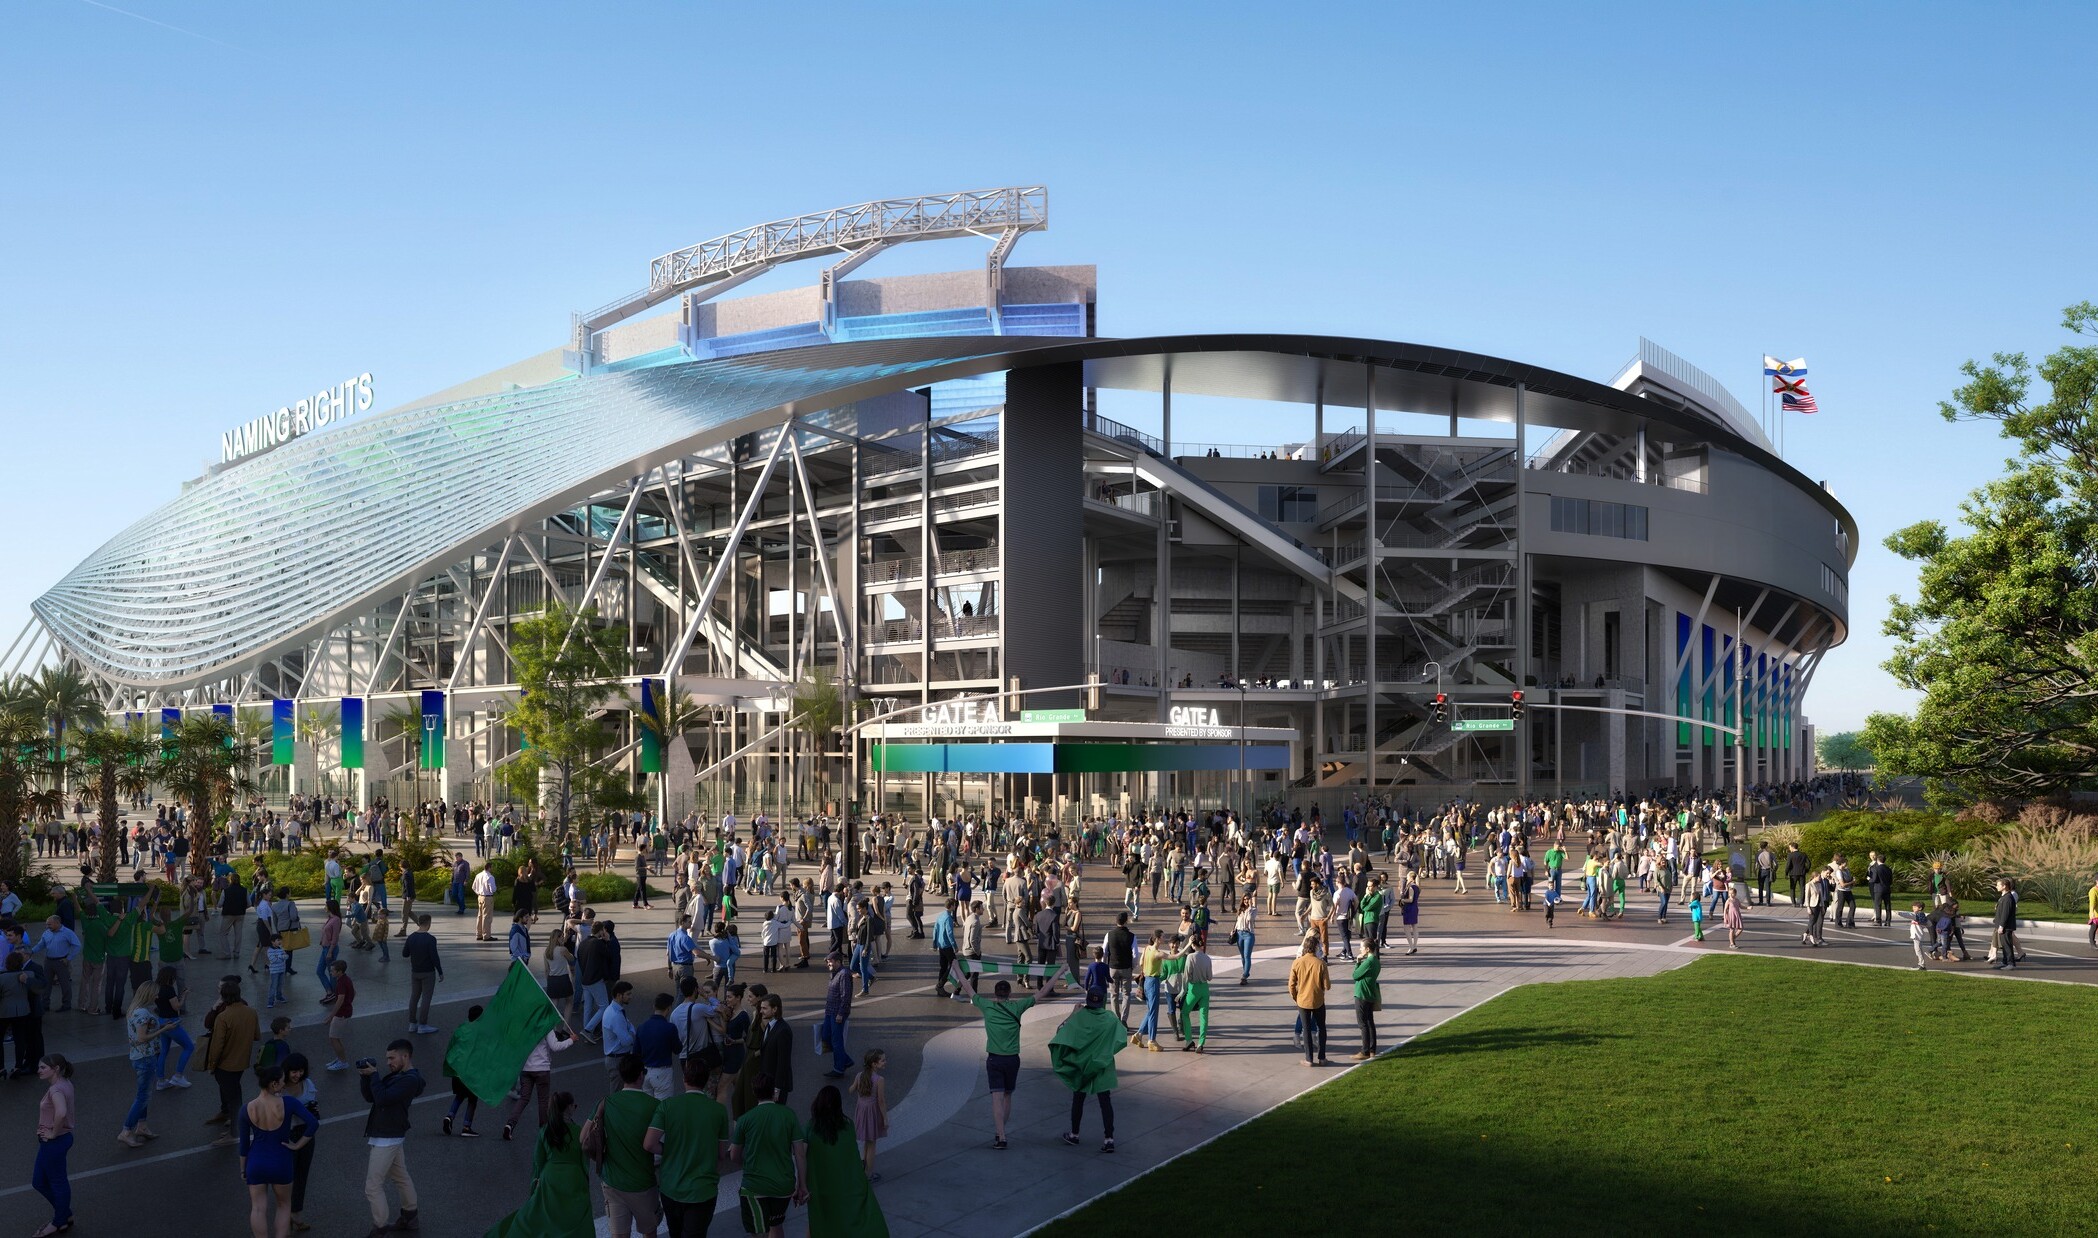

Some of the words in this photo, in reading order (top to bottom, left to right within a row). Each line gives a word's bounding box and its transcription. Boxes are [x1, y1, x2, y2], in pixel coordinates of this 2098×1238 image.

[222, 407, 292, 463] NAMING
[296, 372, 373, 435] RIGHTS
[921, 702, 977, 723] GATE
[984, 701, 999, 723] A
[1169, 706, 1207, 726] GATE
[1209, 708, 1219, 727] A
[904, 726, 953, 735] PRESENTED
[955, 726, 966, 735] BY
[968, 725, 1012, 735] SPONSOR
[1165, 727, 1198, 737] PRESENTED
[1200, 729, 1207, 737] BY
[1208, 728, 1232, 738] SPONSOR
